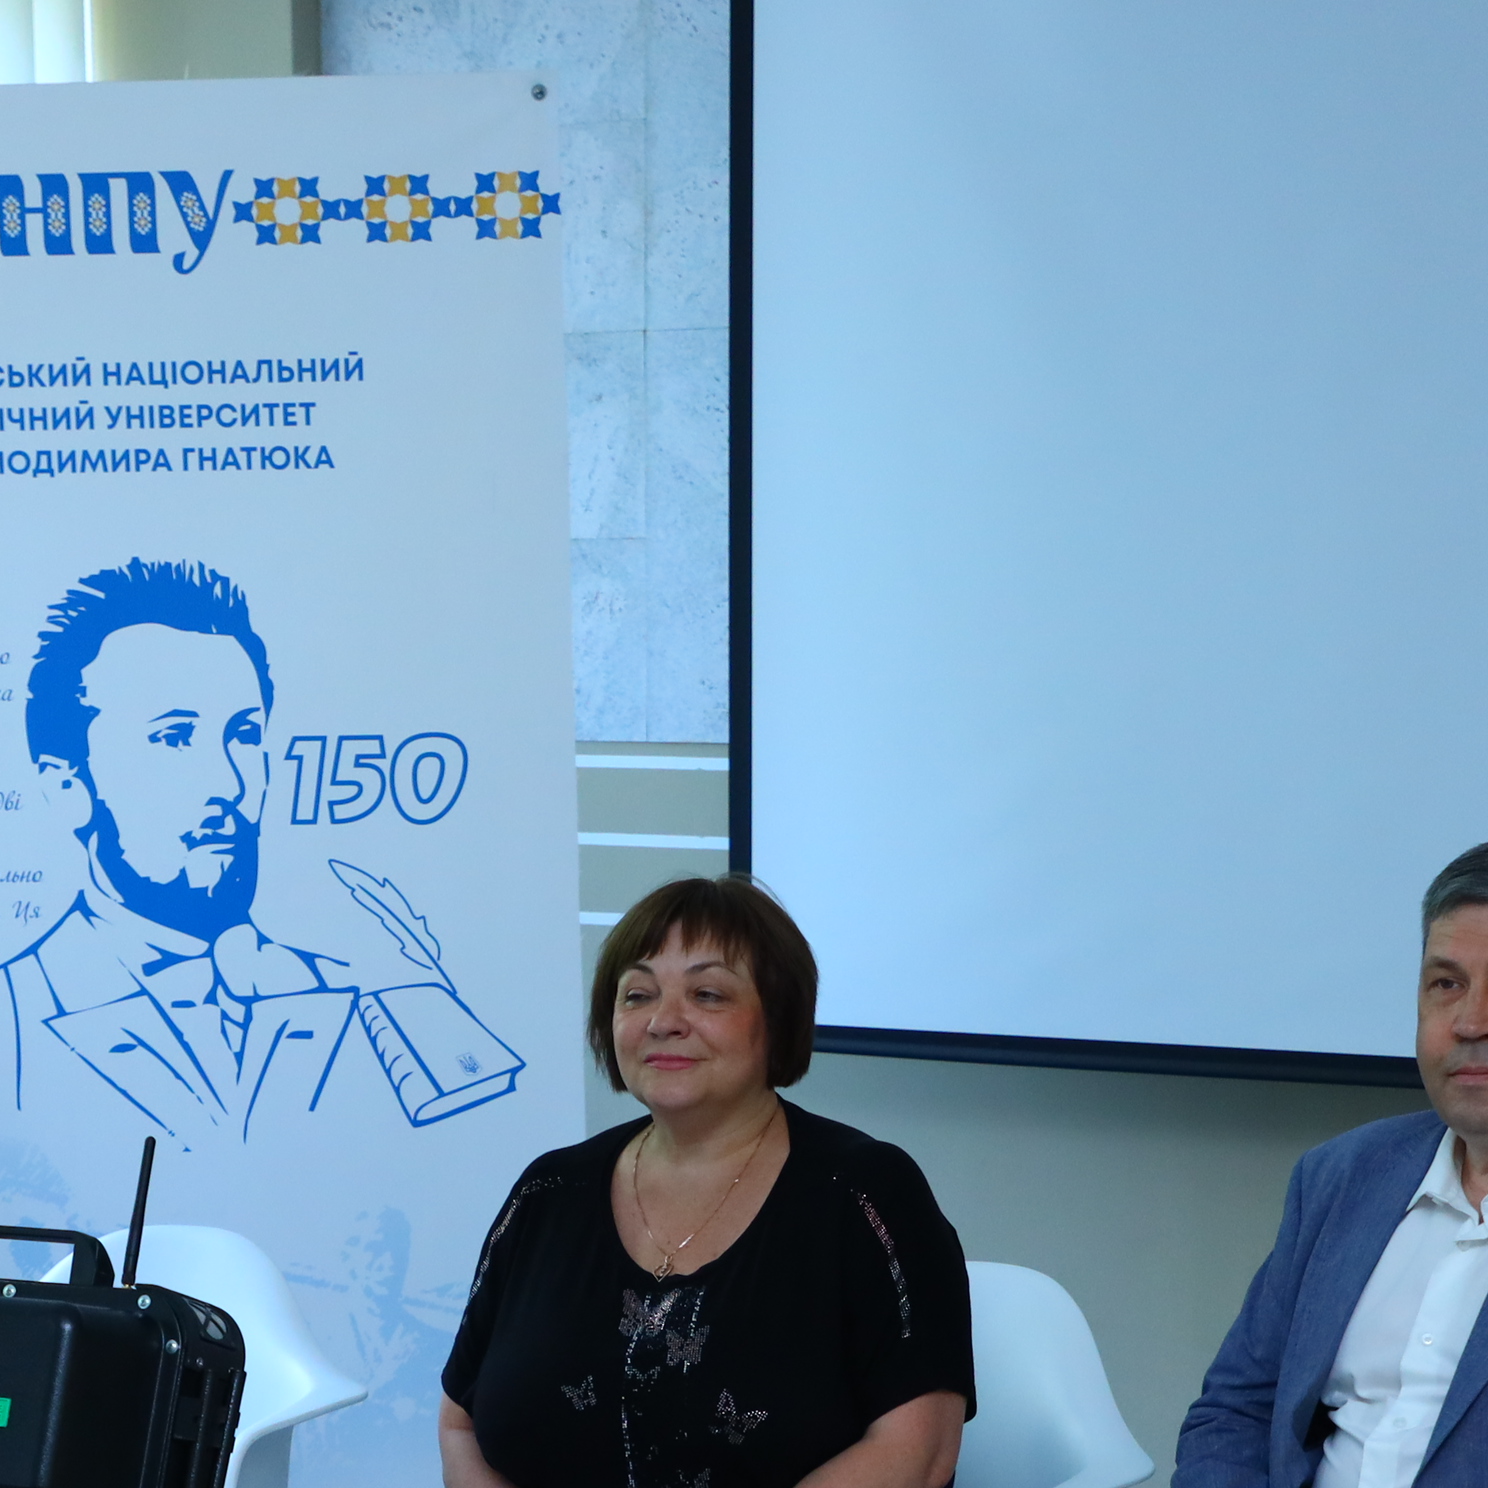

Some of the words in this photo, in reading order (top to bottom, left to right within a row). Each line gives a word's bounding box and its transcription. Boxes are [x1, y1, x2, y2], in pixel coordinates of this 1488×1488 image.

[102, 351, 364, 389] НАЦІОНАЛЬНИЙ
[104, 402, 317, 430] УНІВЕРСИТЕТ
[182, 445, 335, 472] ГНАТЮКА
[283, 731, 469, 826] 150
[12, 900, 42, 926] Ця
